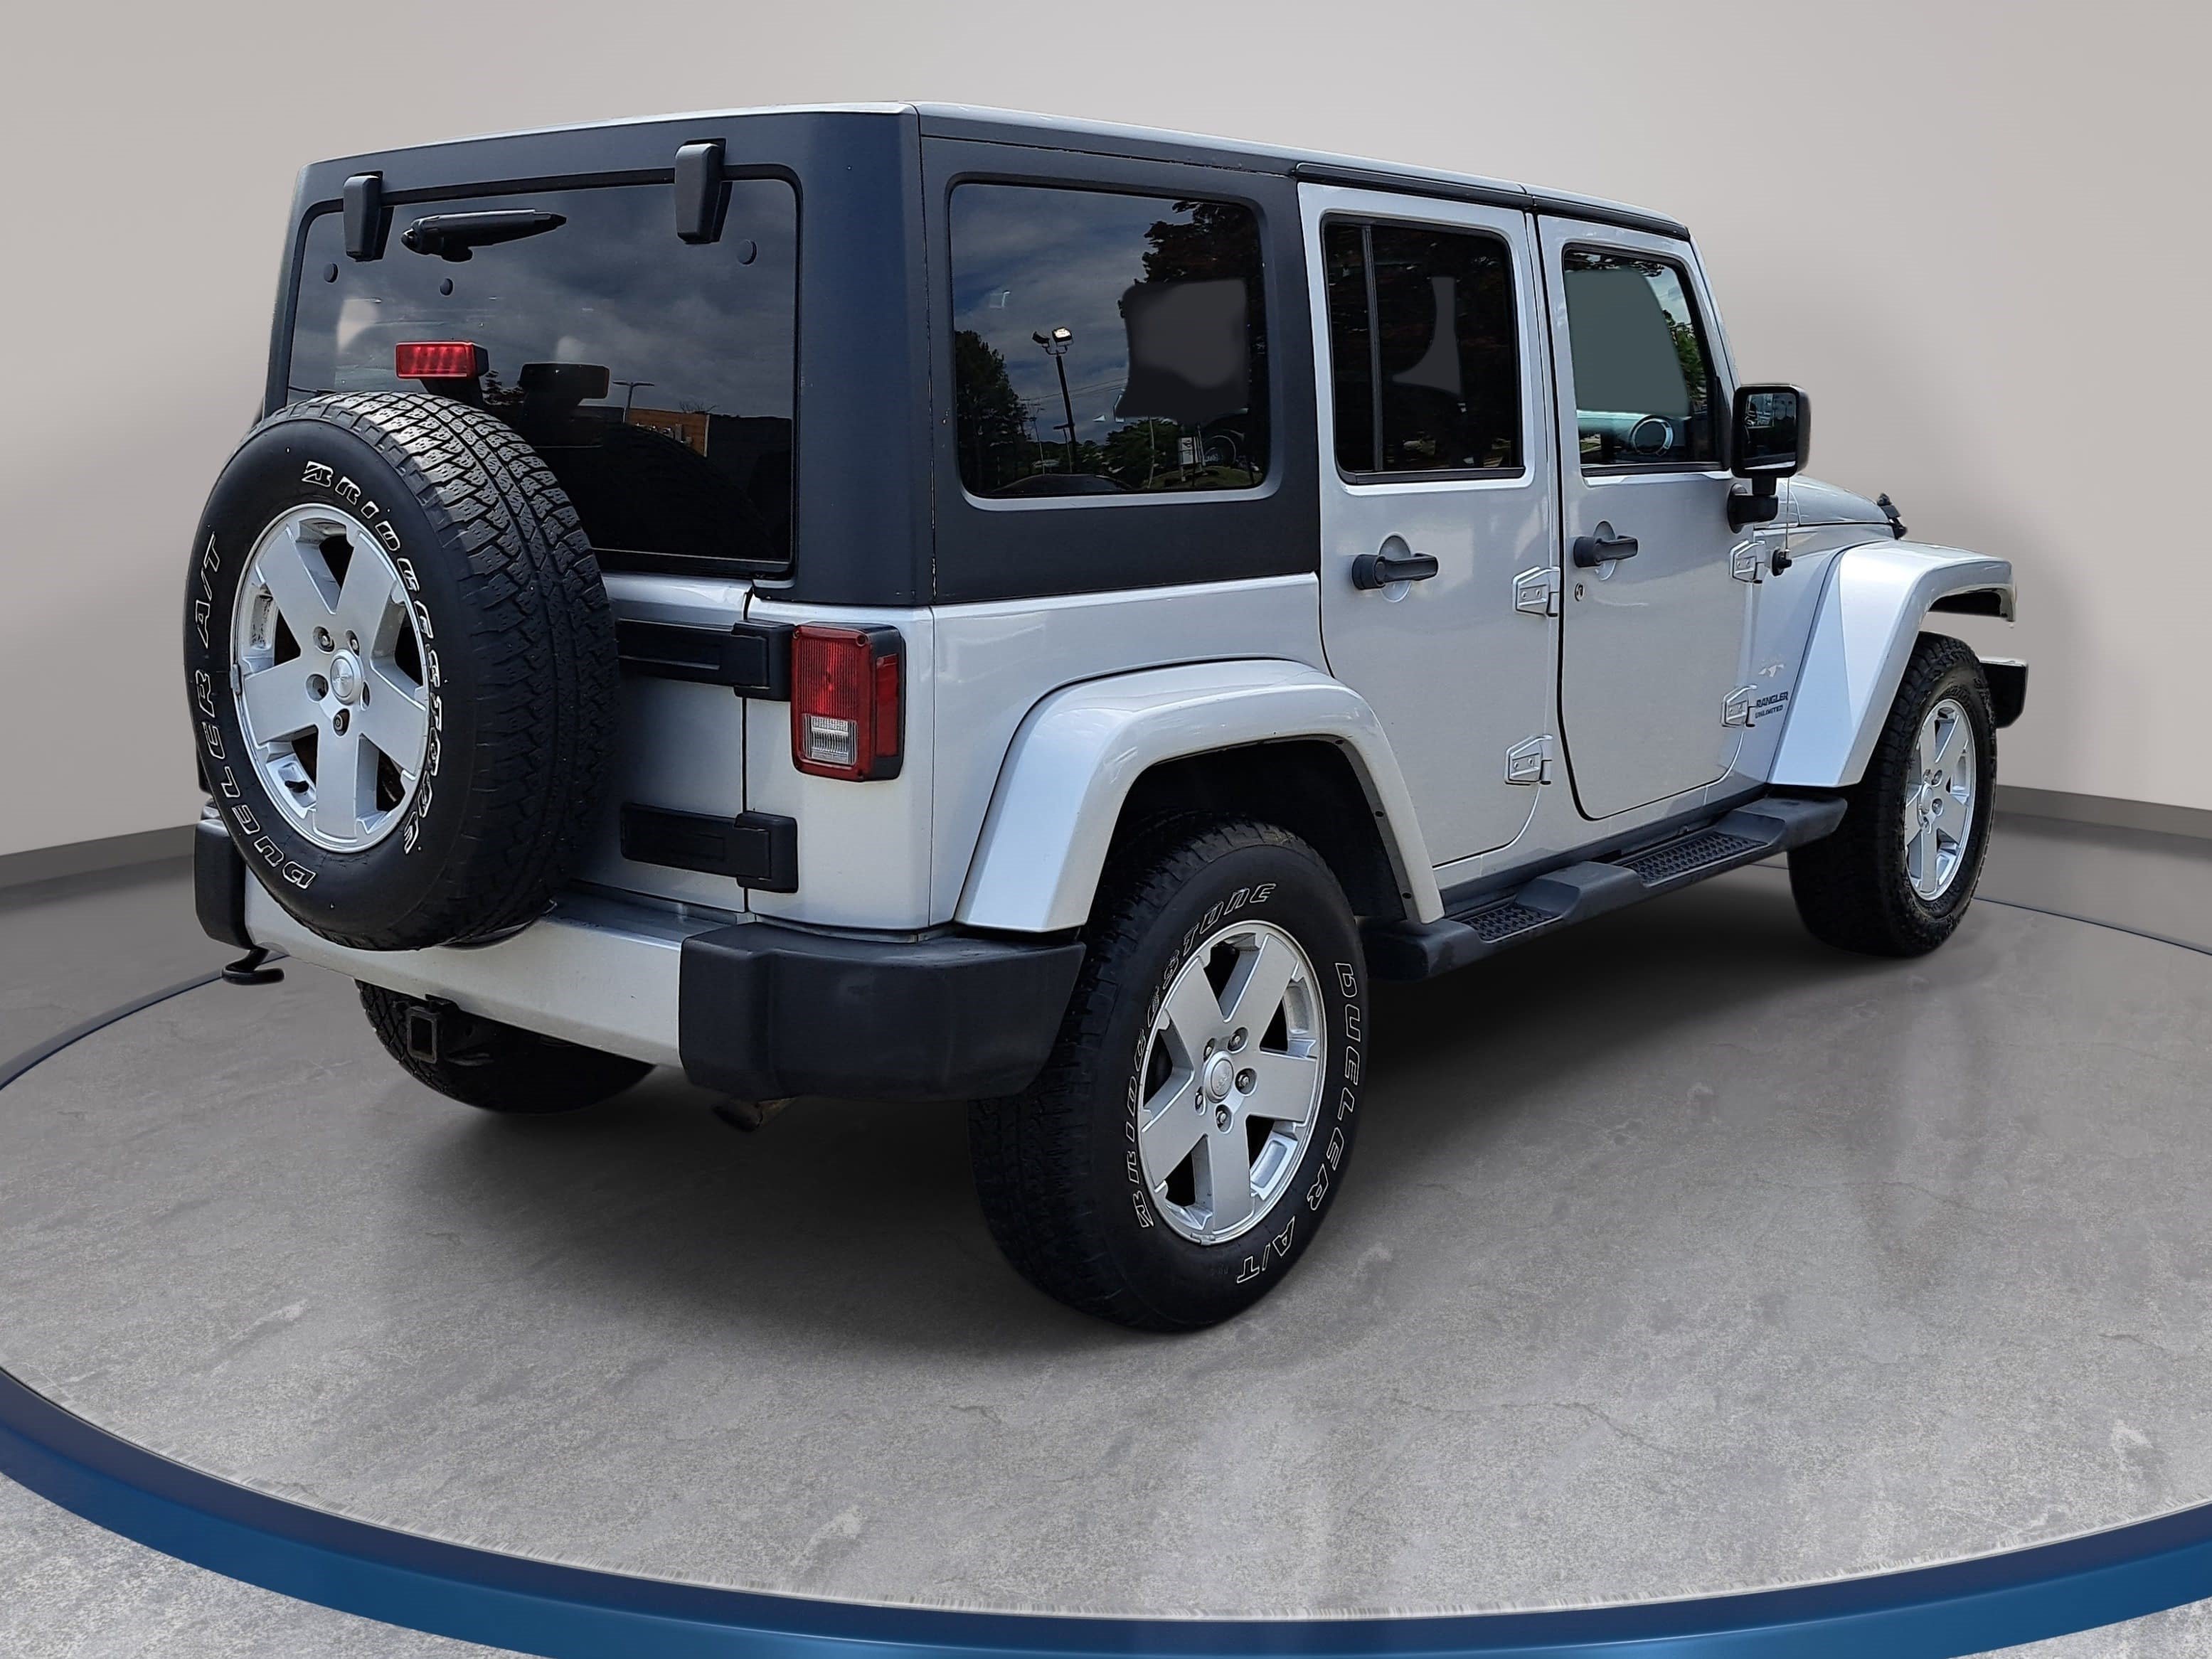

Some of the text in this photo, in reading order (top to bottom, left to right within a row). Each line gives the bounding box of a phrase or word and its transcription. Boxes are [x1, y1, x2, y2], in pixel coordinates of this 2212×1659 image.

[195, 531, 317, 890] DUELER A/T
[301, 460, 442, 854] BRIDGESTONE
[1126, 882, 1277, 1228] BRIDGESTONE
[1236, 962, 1361, 1284] DUELER A/T
